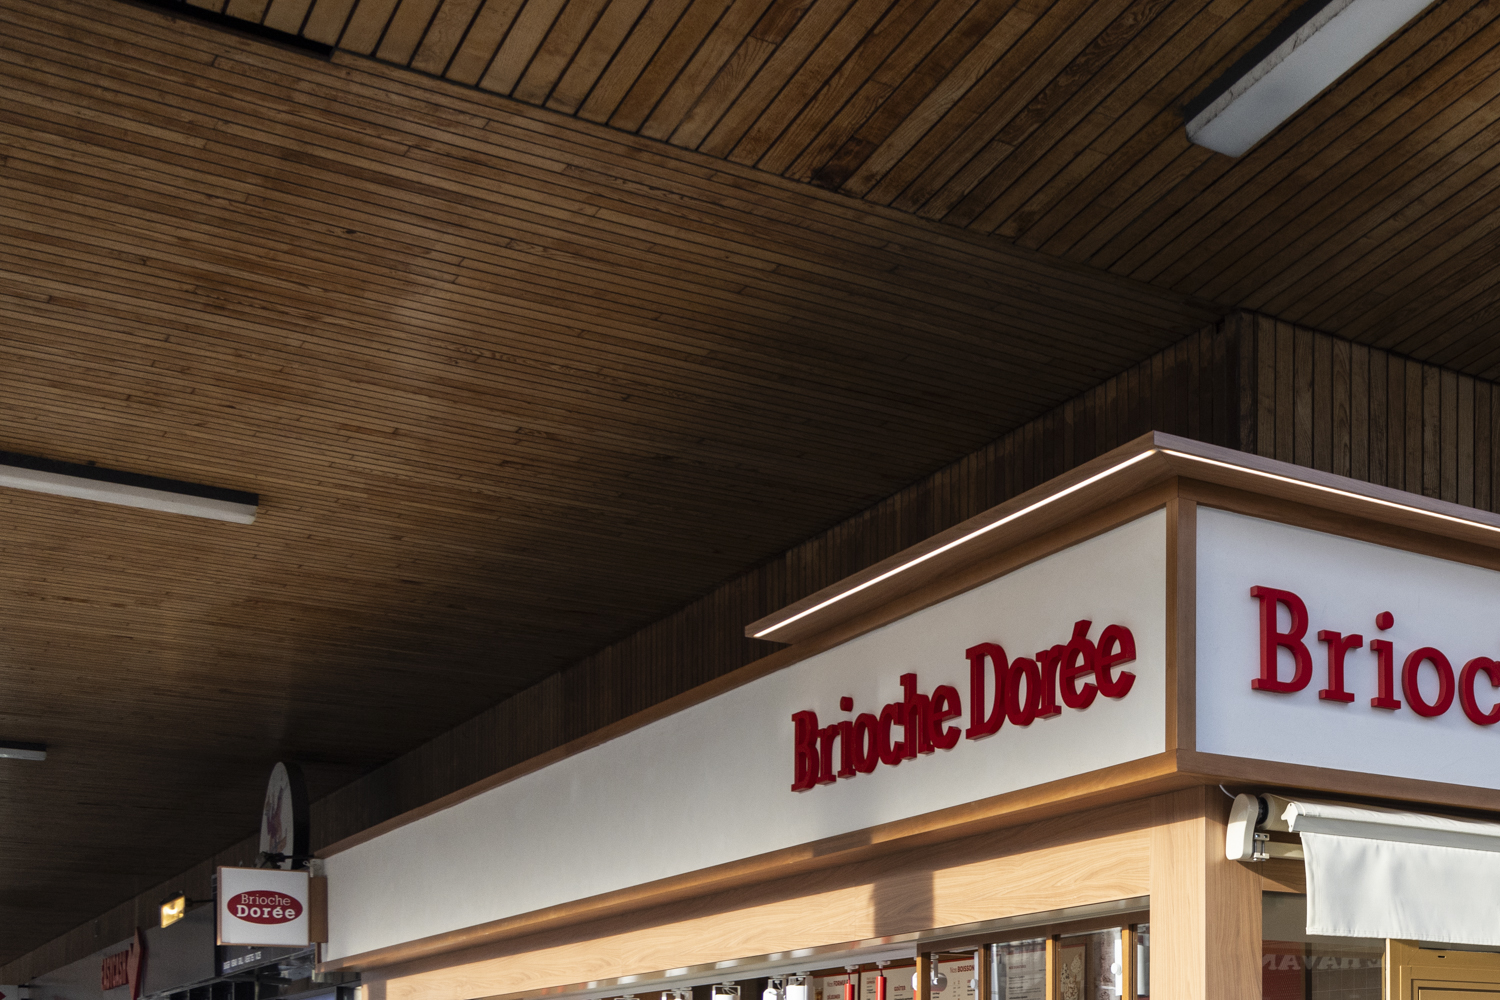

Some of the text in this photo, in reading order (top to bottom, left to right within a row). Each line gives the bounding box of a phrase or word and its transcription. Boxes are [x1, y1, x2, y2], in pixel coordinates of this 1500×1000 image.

[791, 619, 1137, 793] Brioche Dorée
[241, 893, 291, 906] Brioche
[236, 904, 296, 919] Dorée
[957, 965, 974, 973] BOISSON
